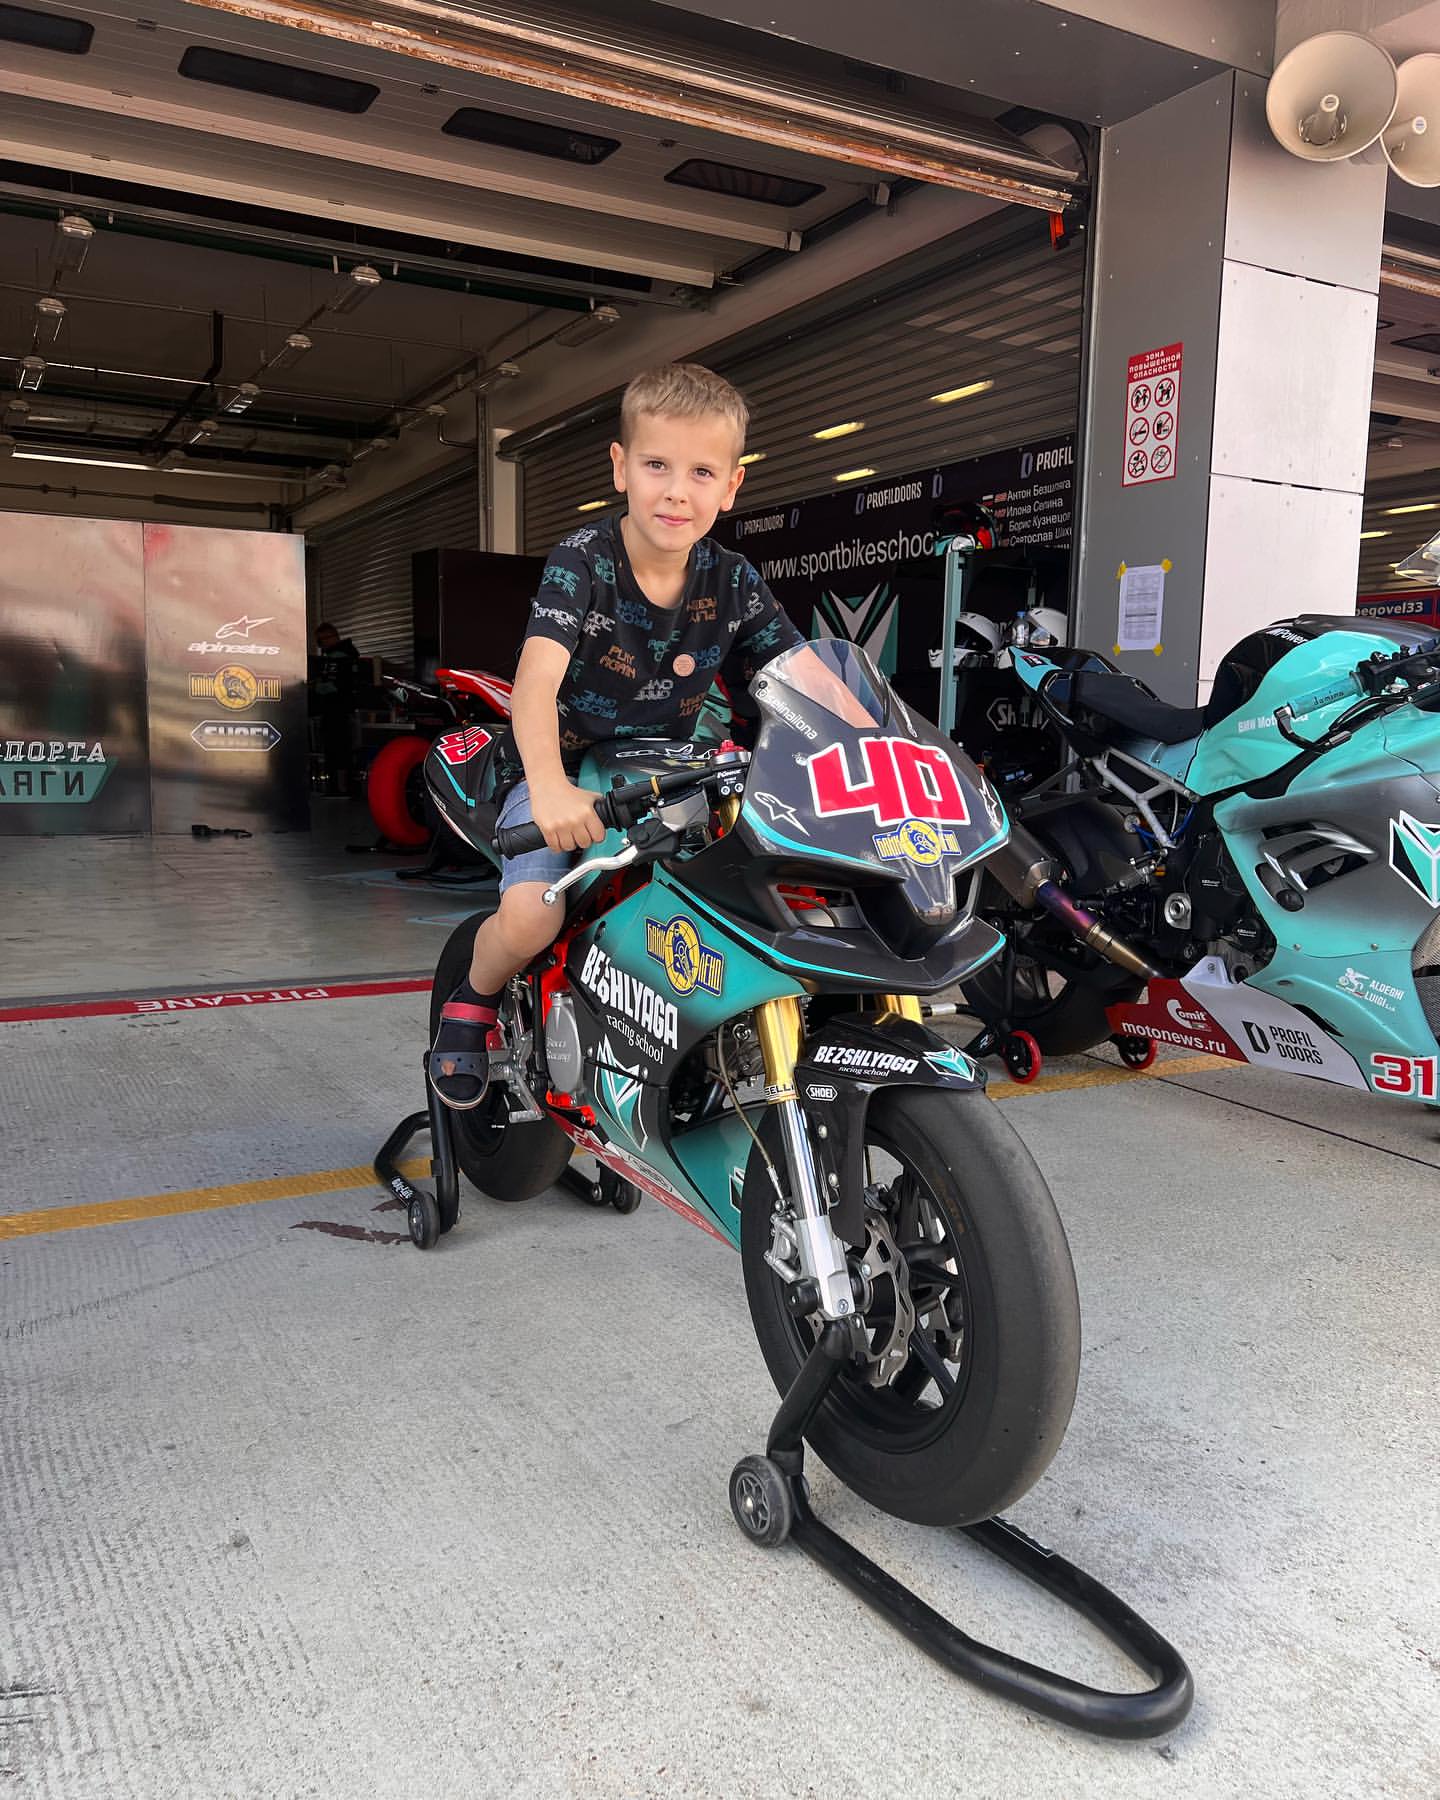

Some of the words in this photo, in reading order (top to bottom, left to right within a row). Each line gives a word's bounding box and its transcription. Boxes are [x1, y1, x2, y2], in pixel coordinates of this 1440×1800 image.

[1145, 350, 1165, 361] ЗОНА
[1133, 362, 1177, 379] ОПАСНОСТИ
[866, 482, 922, 509] PROFILDOORS
[1008, 489, 1031, 501] Антон
[1007, 505, 1031, 518] Илона
[188, 642, 280, 655] alpinestars
[0, 741, 106, 762] ПОРТА
[808, 736, 970, 827] 40
[134, 989, 329, 1011] PIT-LANE
[606, 1014, 635, 1046] racing
[636, 1033, 664, 1064] school
[1121, 1022, 1226, 1054] motonews.ru
[1269, 1025, 1317, 1049] PROFIL
[814, 1045, 919, 1075] BEZSHLYAGA
[1277, 1043, 1323, 1065] DOORS
[838, 1066, 861, 1076] racing
[862, 1067, 890, 1077] school
[1371, 1052, 1438, 1100] 31
[810, 1087, 833, 1099] SHOEI
